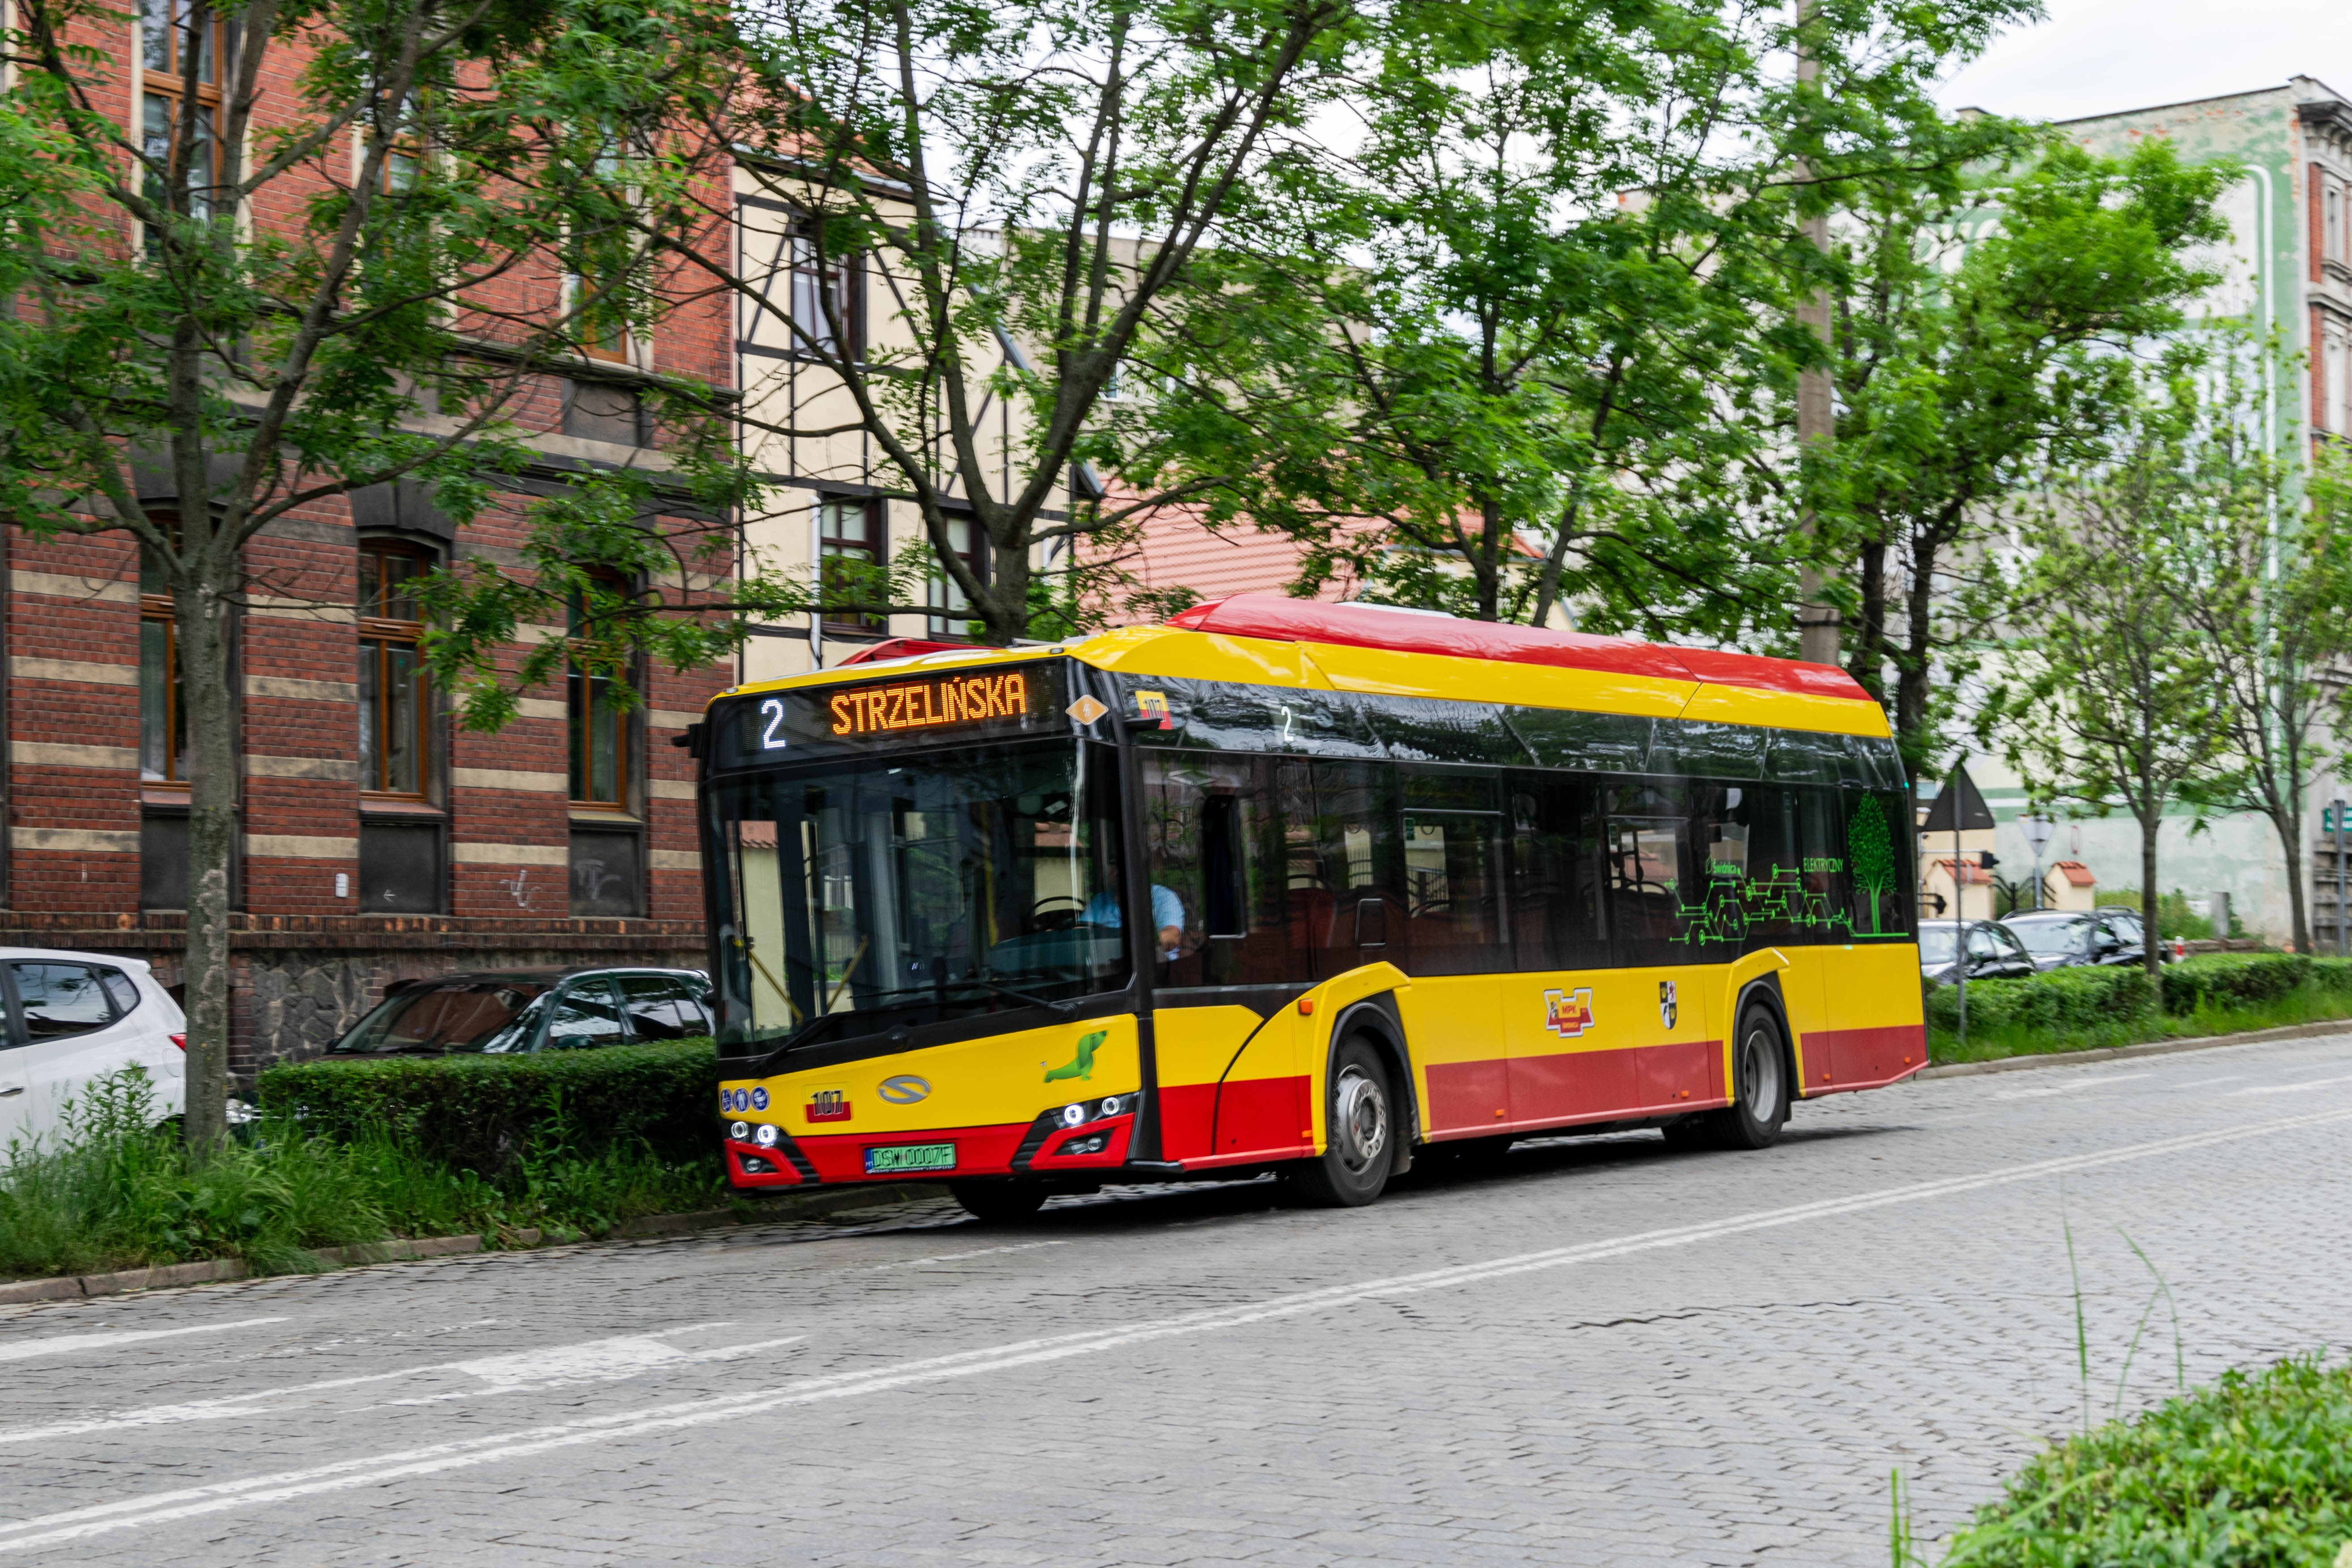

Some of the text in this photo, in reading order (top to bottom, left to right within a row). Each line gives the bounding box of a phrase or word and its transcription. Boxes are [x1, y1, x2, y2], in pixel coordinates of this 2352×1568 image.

[761, 674, 1026, 749] 2 STRZELIŃSKA
[1280, 706, 1294, 741] 2
[1713, 859, 1737, 874] Świdnica
[1803, 857, 1843, 873] ELEKTRYCZNY
[810, 1089, 843, 1115] 107
[873, 1148, 902, 1167] DSW
